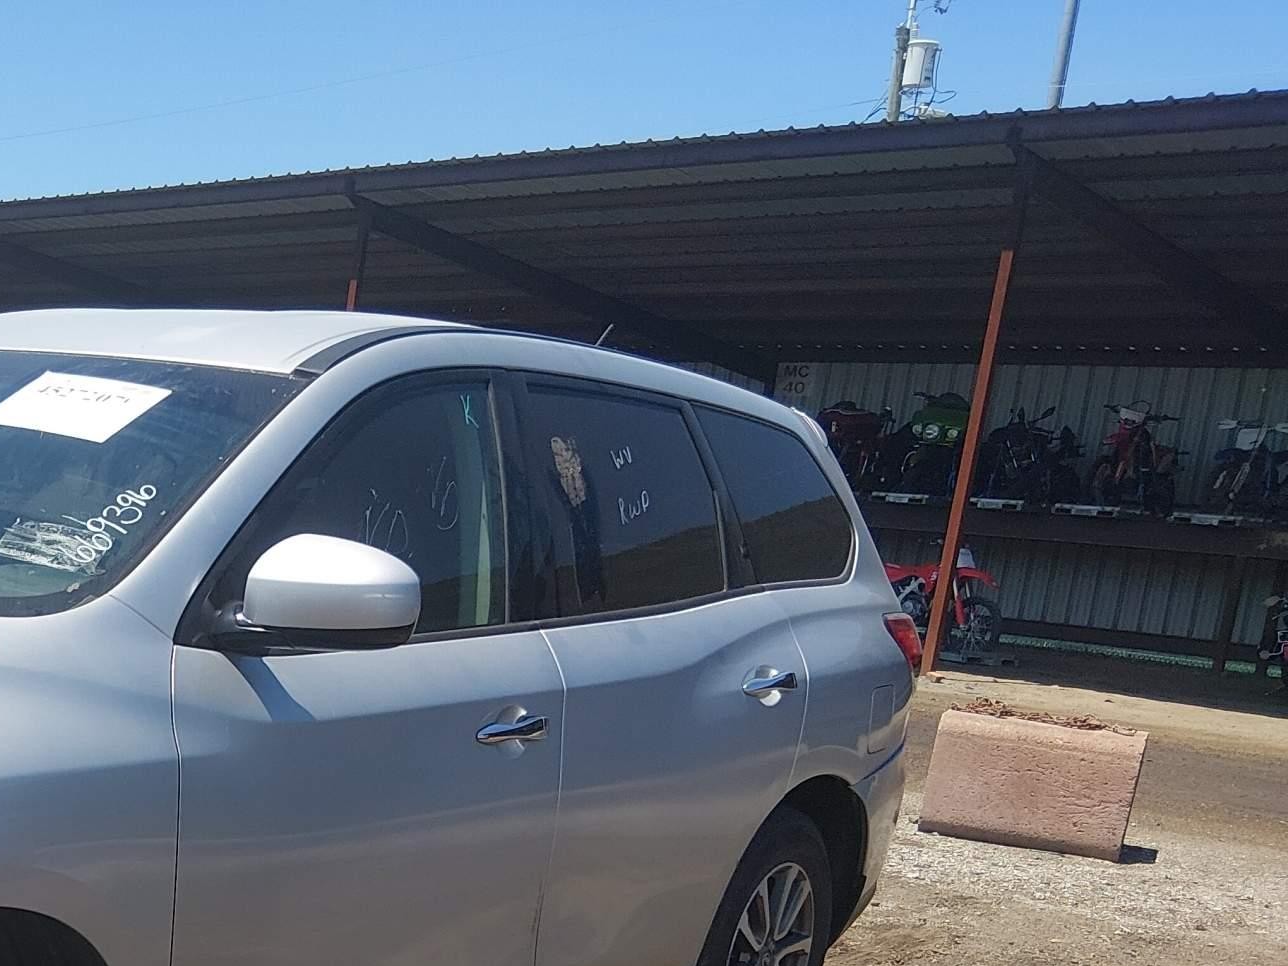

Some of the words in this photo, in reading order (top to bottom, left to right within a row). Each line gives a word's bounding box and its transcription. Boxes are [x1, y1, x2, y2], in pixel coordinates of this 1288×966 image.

[783, 365, 810, 378] MC
[783, 382, 805, 394] 40
[460, 395, 479, 429] K
